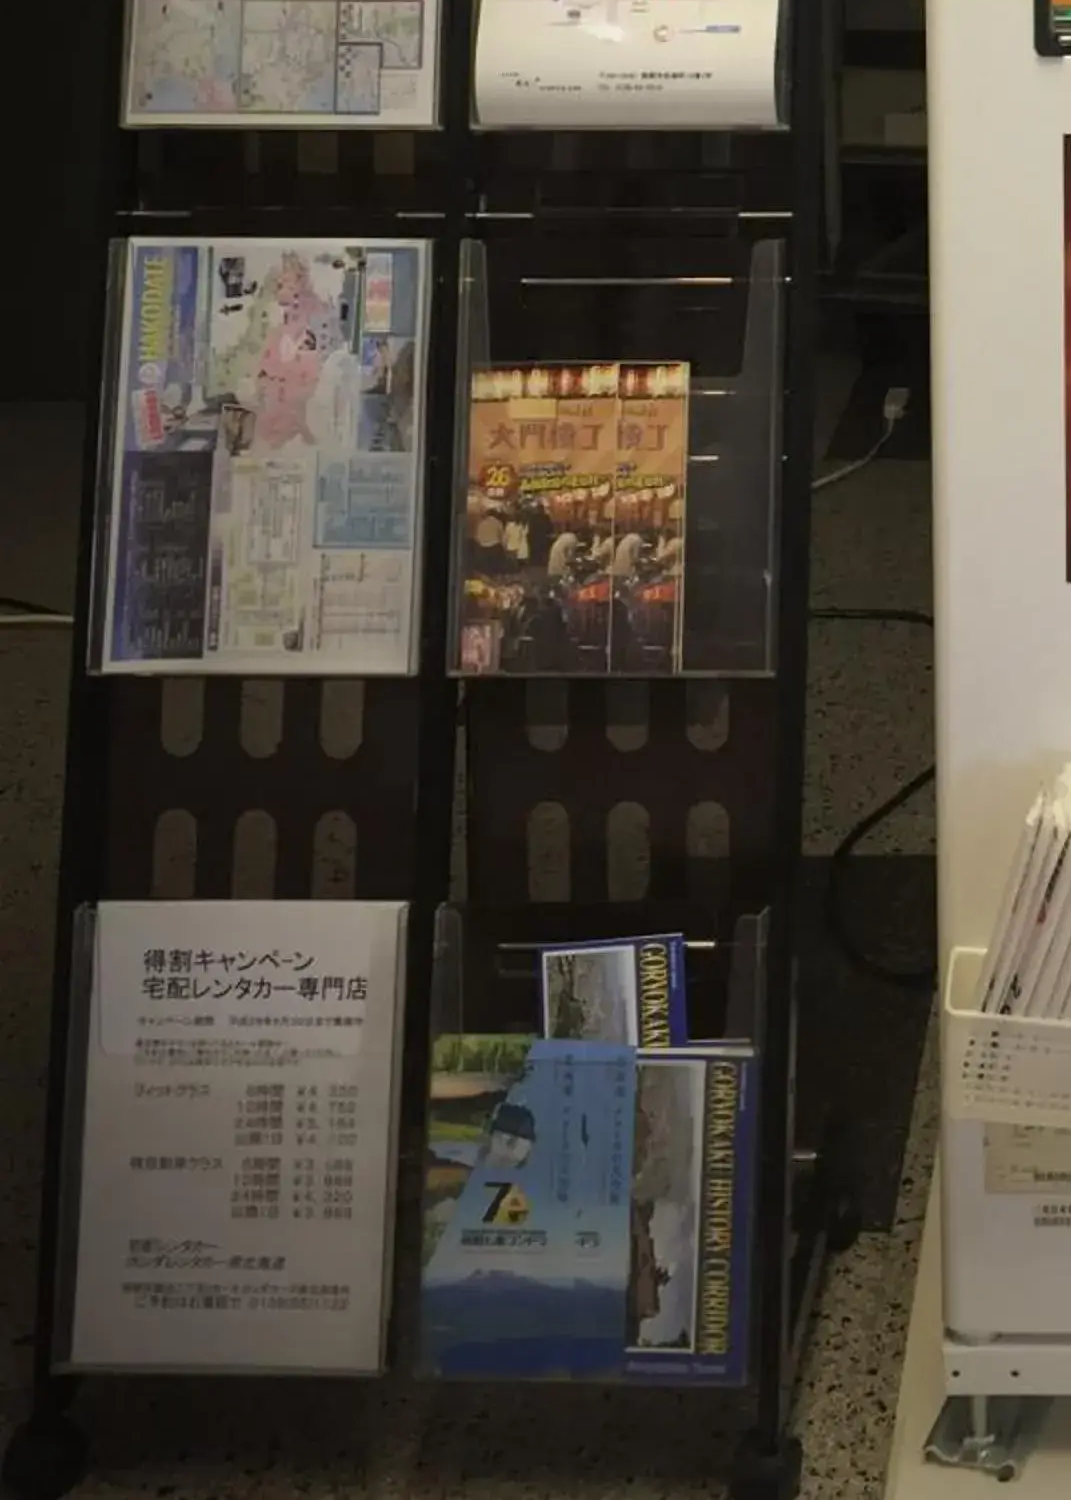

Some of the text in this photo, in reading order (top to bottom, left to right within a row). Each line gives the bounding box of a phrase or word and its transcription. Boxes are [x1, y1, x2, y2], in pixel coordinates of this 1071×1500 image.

[139, 254, 168, 362] HAKODATE
[141, 976, 369, 1002] 宅配レンタカー専門店
[143, 948, 316, 975] 得割キャンペーン
[699, 1061, 738, 1356] GORYOKAKU HISTORY CORRIDOR
